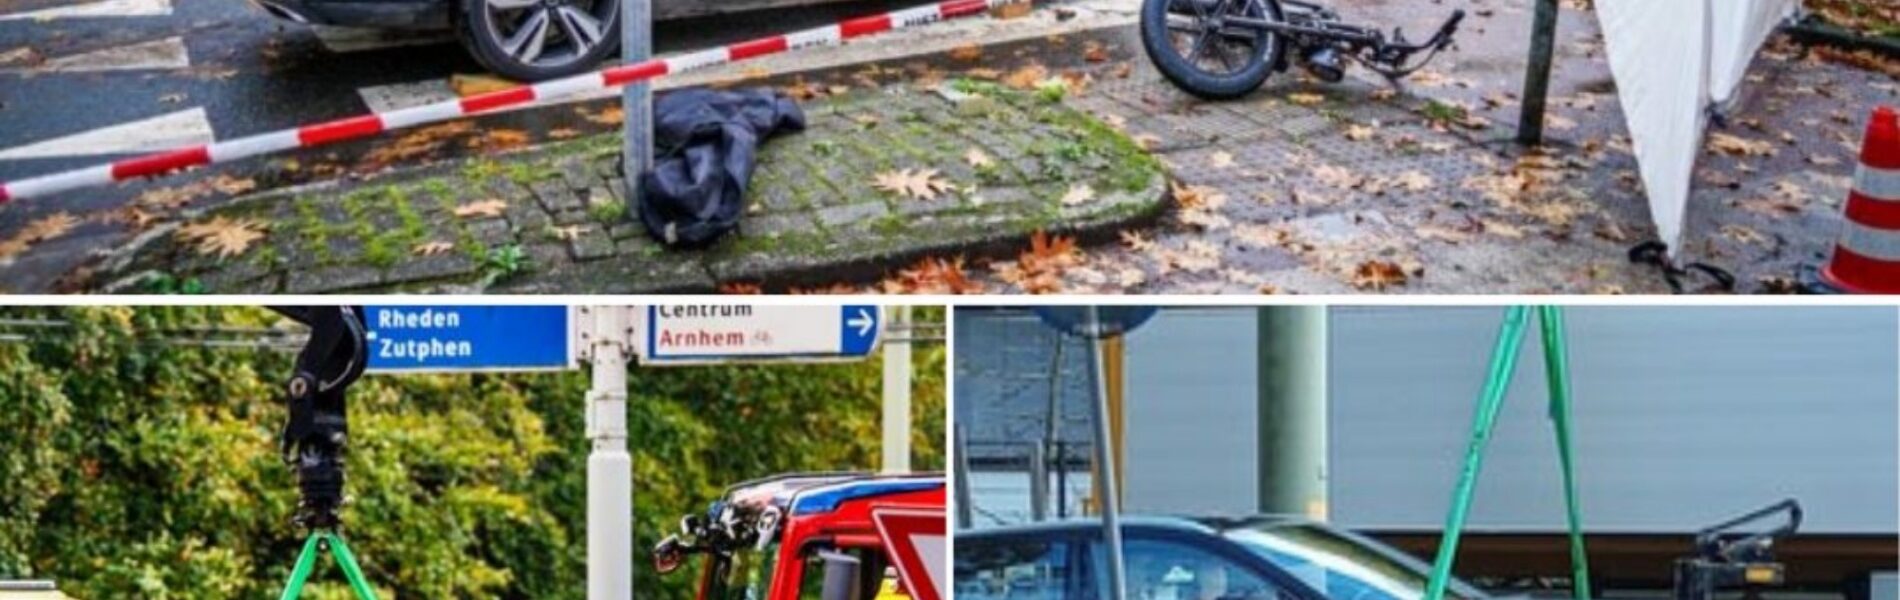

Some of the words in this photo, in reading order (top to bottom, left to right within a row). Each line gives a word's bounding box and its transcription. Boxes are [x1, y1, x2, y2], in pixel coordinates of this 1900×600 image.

[379, 309, 460, 328] Rheden
[659, 304, 752, 318] Centrum
[660, 329, 744, 346] Arnhem
[379, 338, 471, 362] Zutphen
